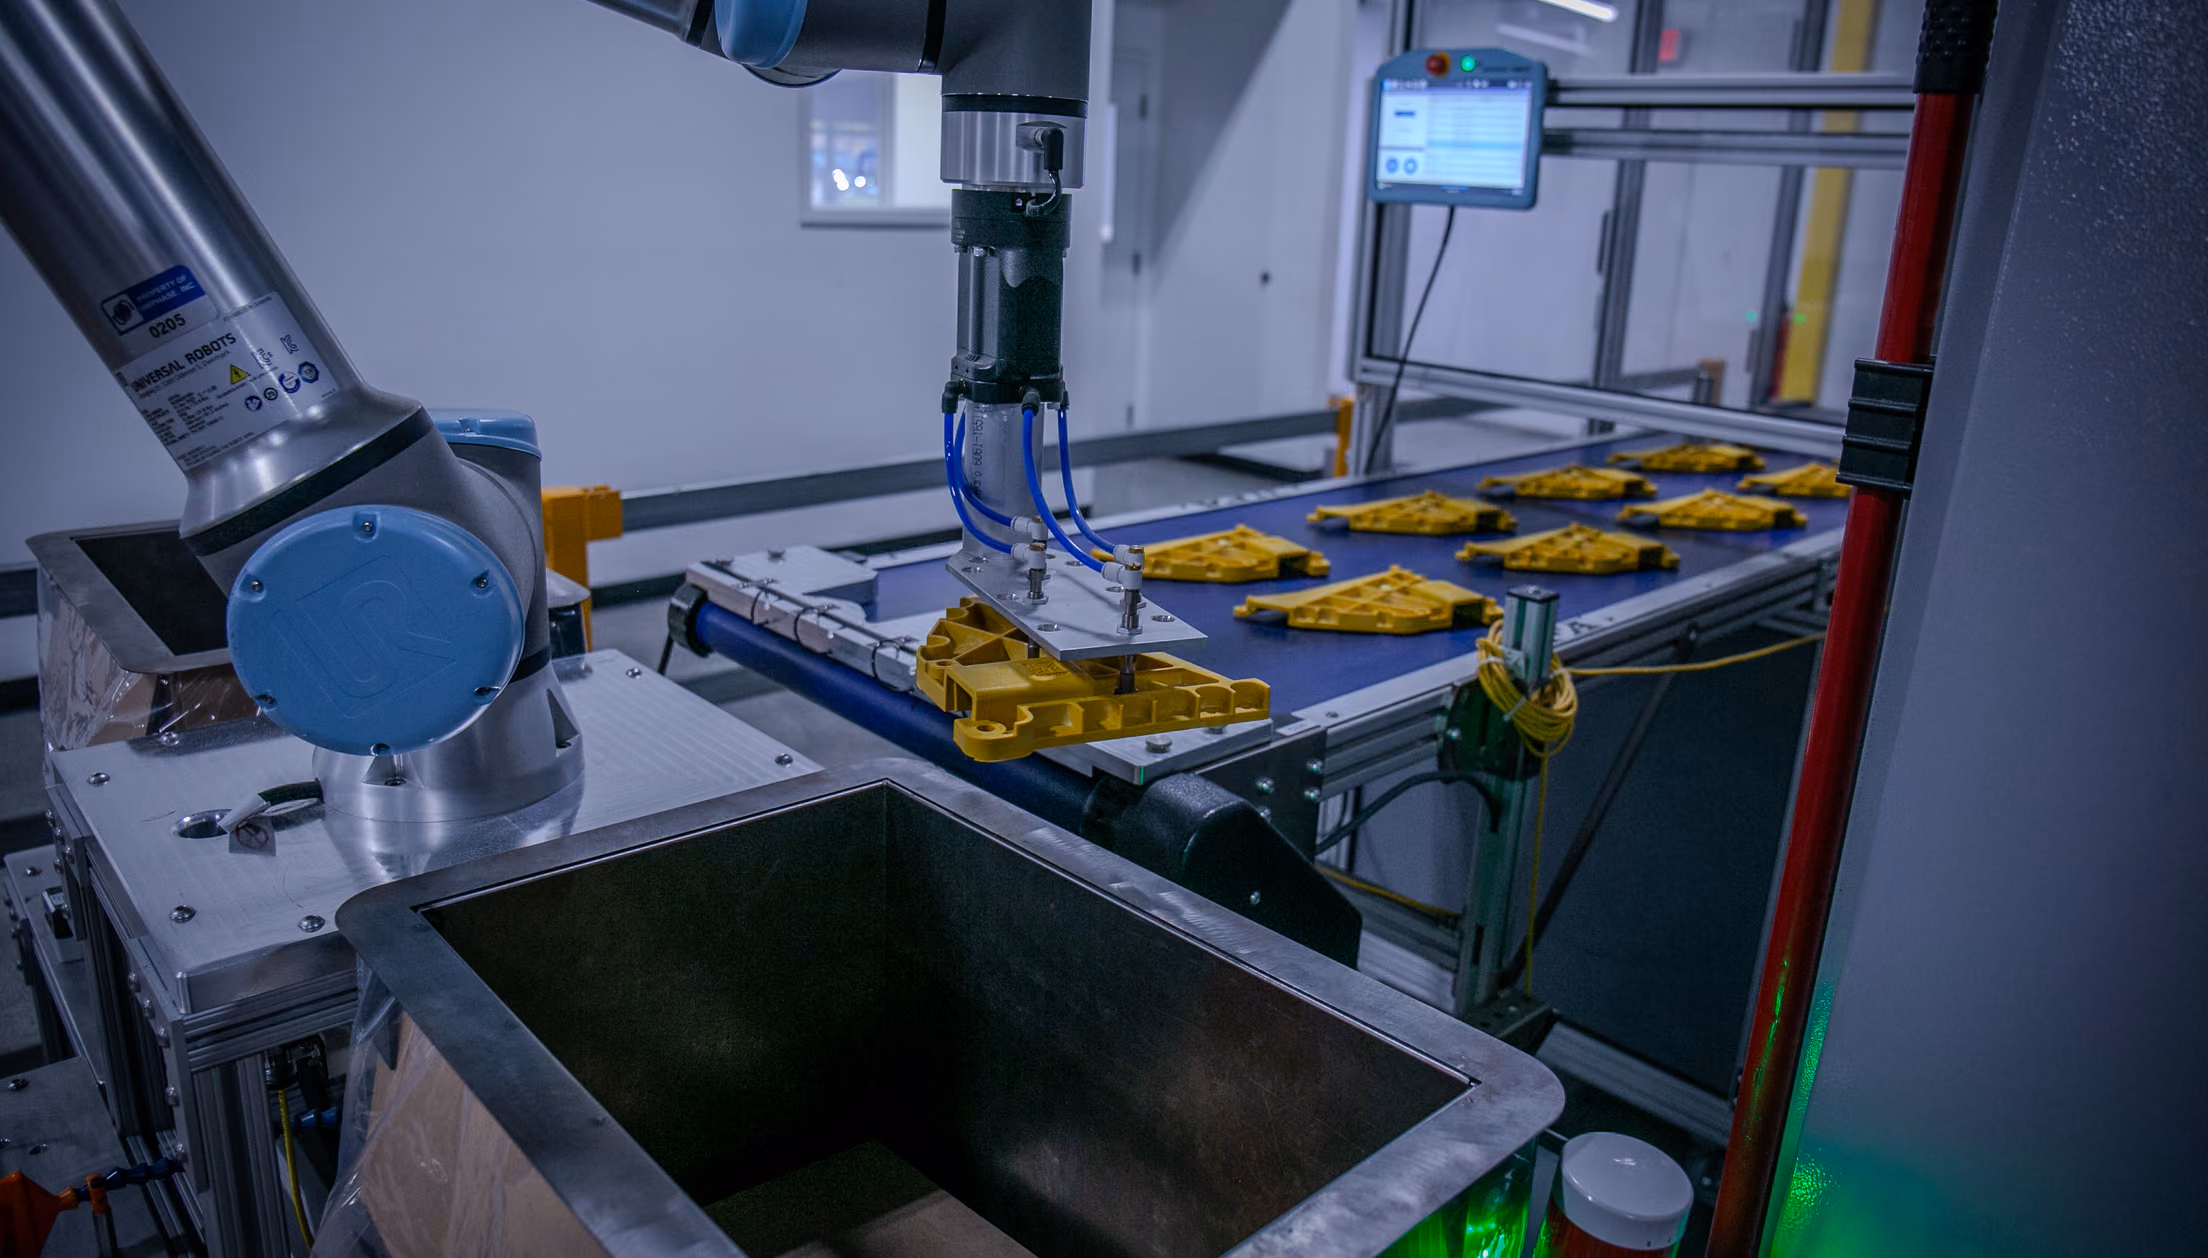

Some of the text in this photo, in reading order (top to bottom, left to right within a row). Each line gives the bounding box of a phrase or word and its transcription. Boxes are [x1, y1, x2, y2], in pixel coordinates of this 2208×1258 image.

[136, 274, 188, 301] PROPERTY OF
[149, 313, 186, 338] 0205
[130, 359, 186, 392] UNIVERSAL
[184, 332, 237, 365] ROBOTS
